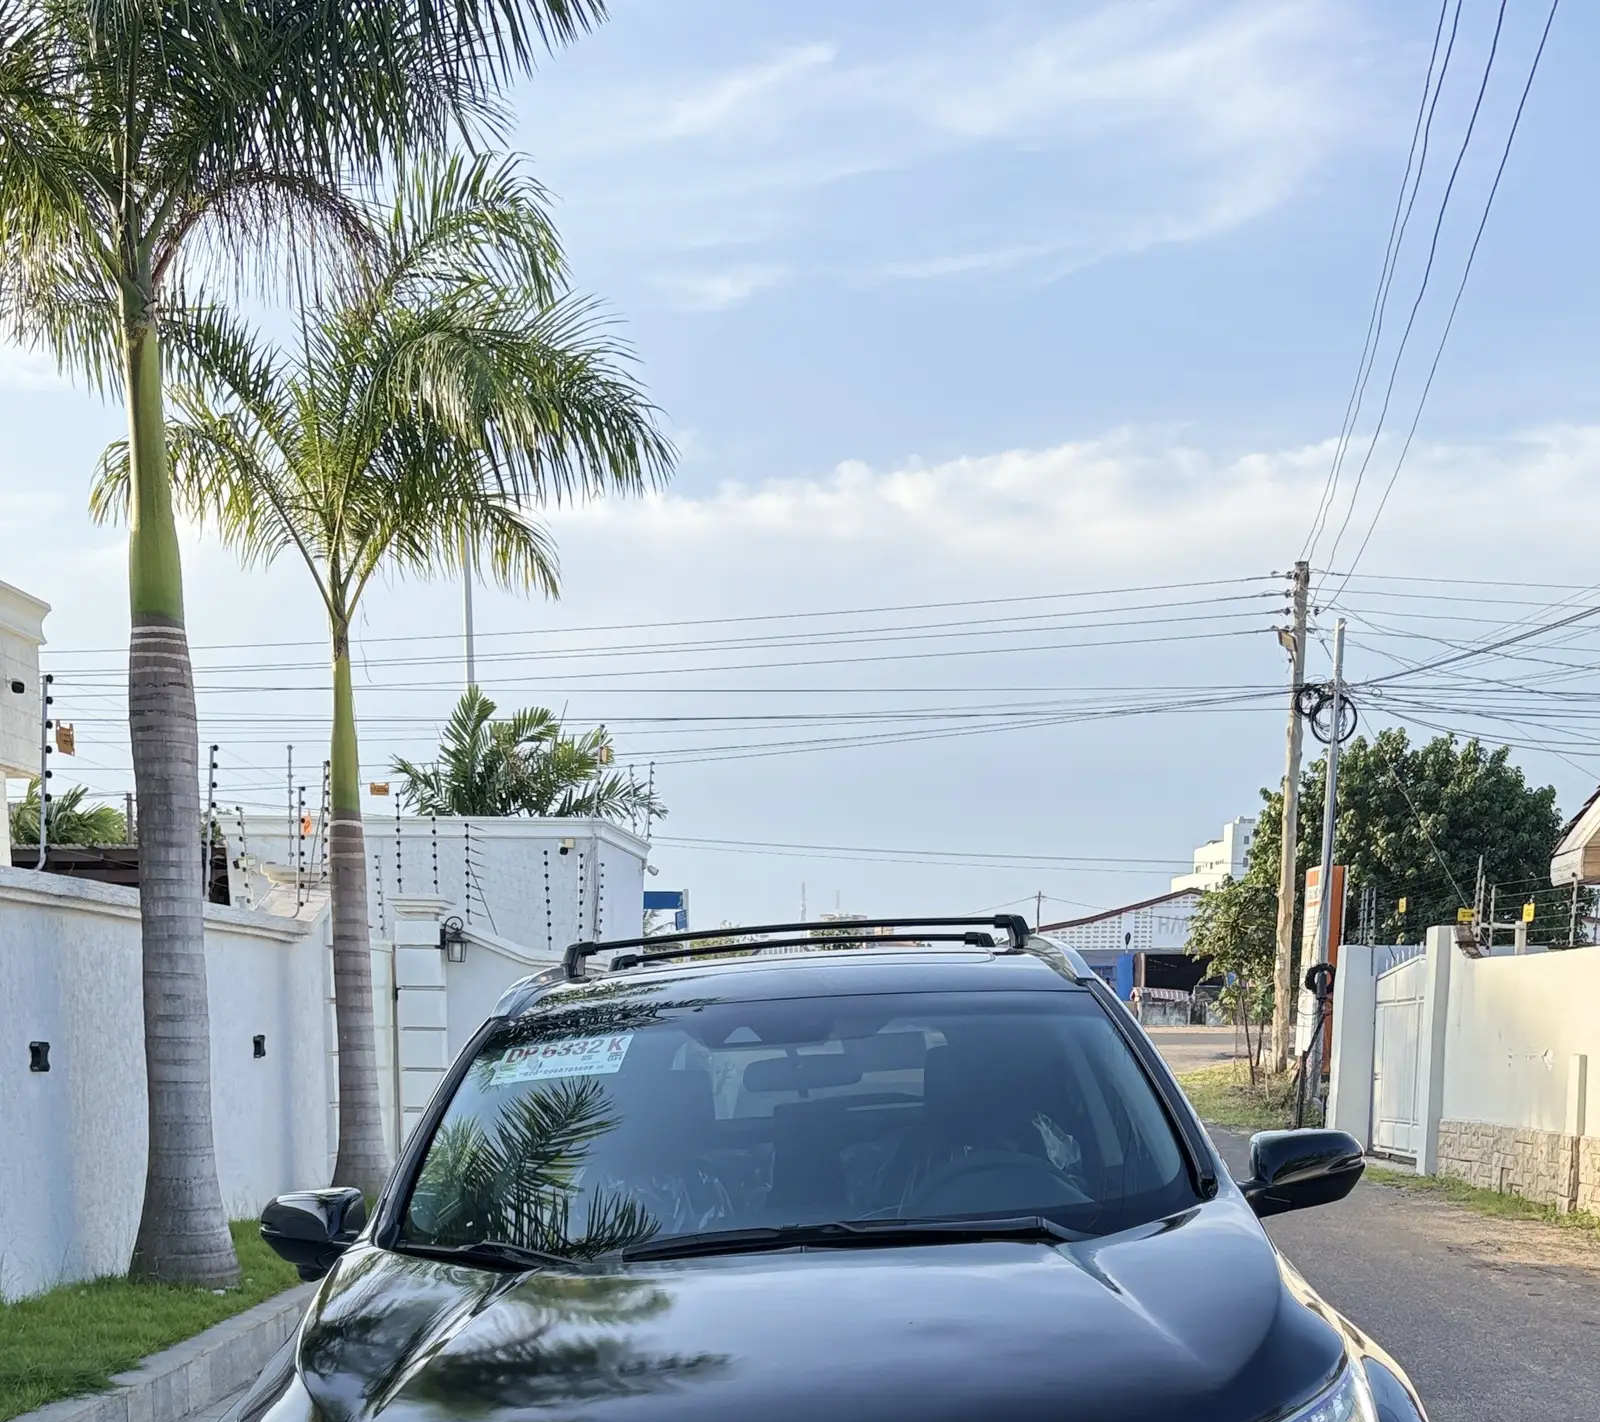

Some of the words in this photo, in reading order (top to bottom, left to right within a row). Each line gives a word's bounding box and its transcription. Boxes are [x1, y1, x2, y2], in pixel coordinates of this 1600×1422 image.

[506, 1046, 540, 1064] DP
[541, 1038, 605, 1058] 6332
[606, 1036, 627, 1053] K
